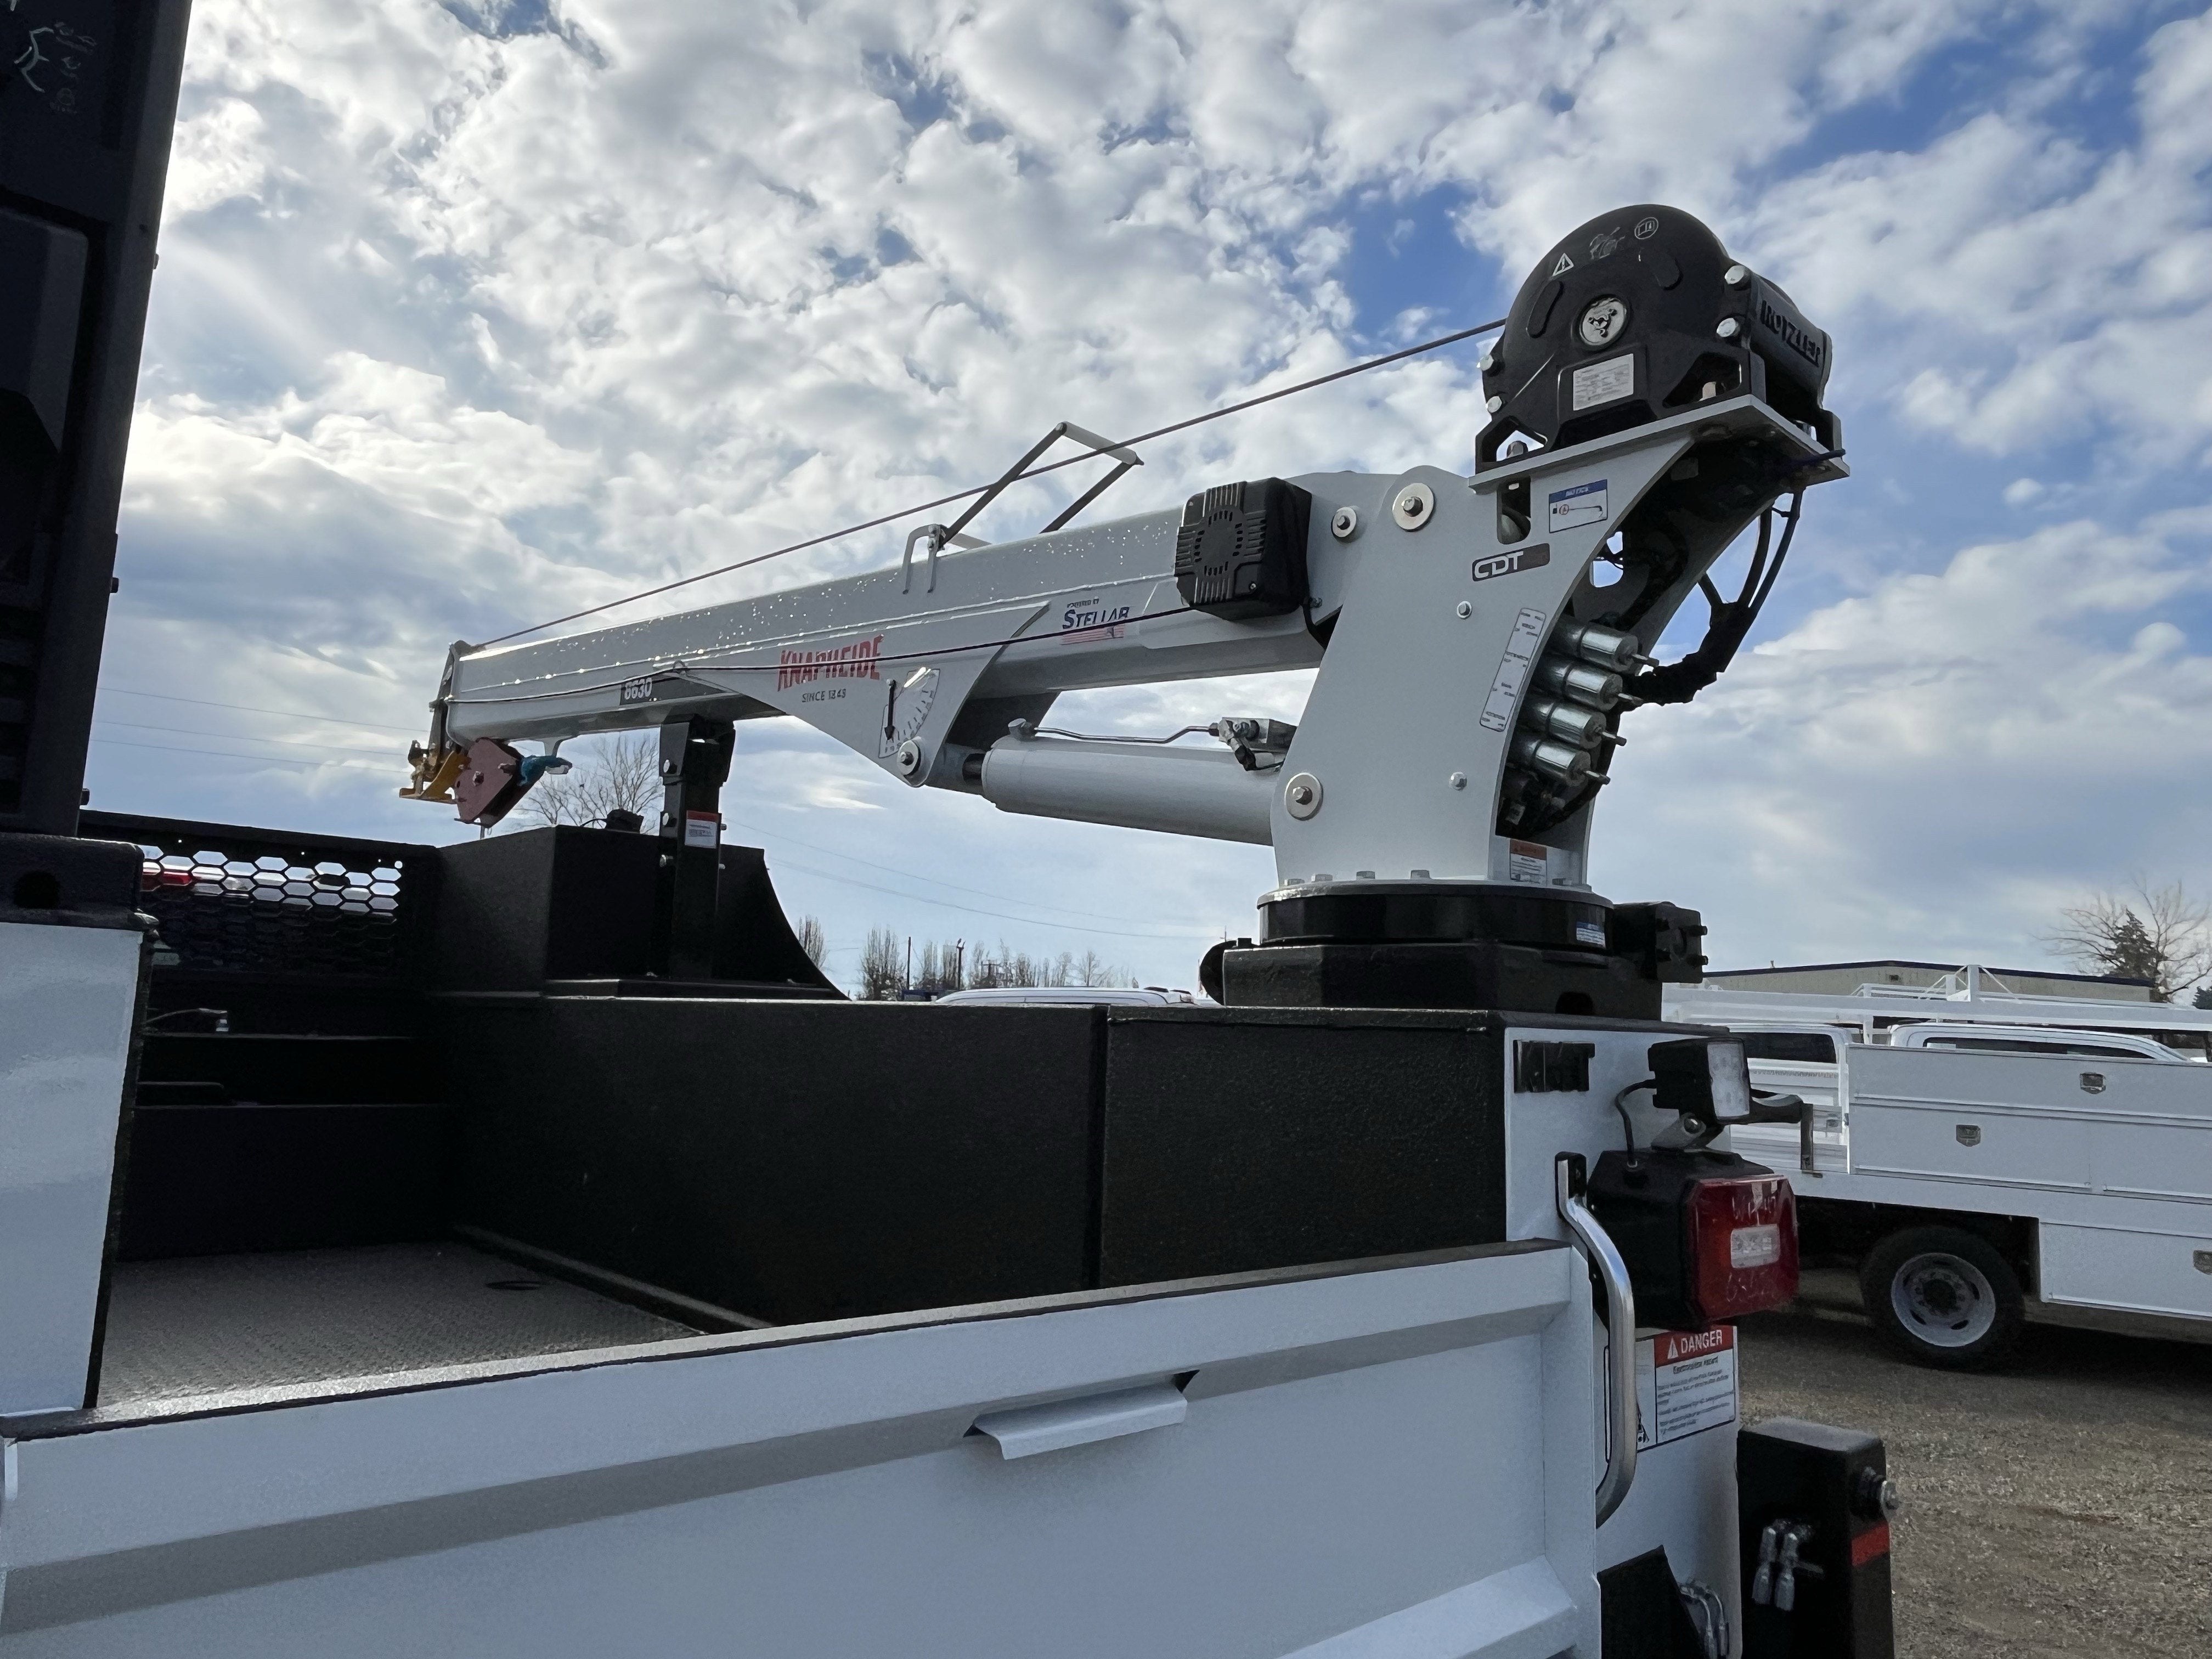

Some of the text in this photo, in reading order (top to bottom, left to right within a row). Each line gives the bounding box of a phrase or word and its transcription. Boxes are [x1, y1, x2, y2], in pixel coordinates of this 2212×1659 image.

[1474, 551, 1524, 579] CDT
[802, 690, 825, 703] SINCE
[1681, 1329, 1723, 1354] DANGER
